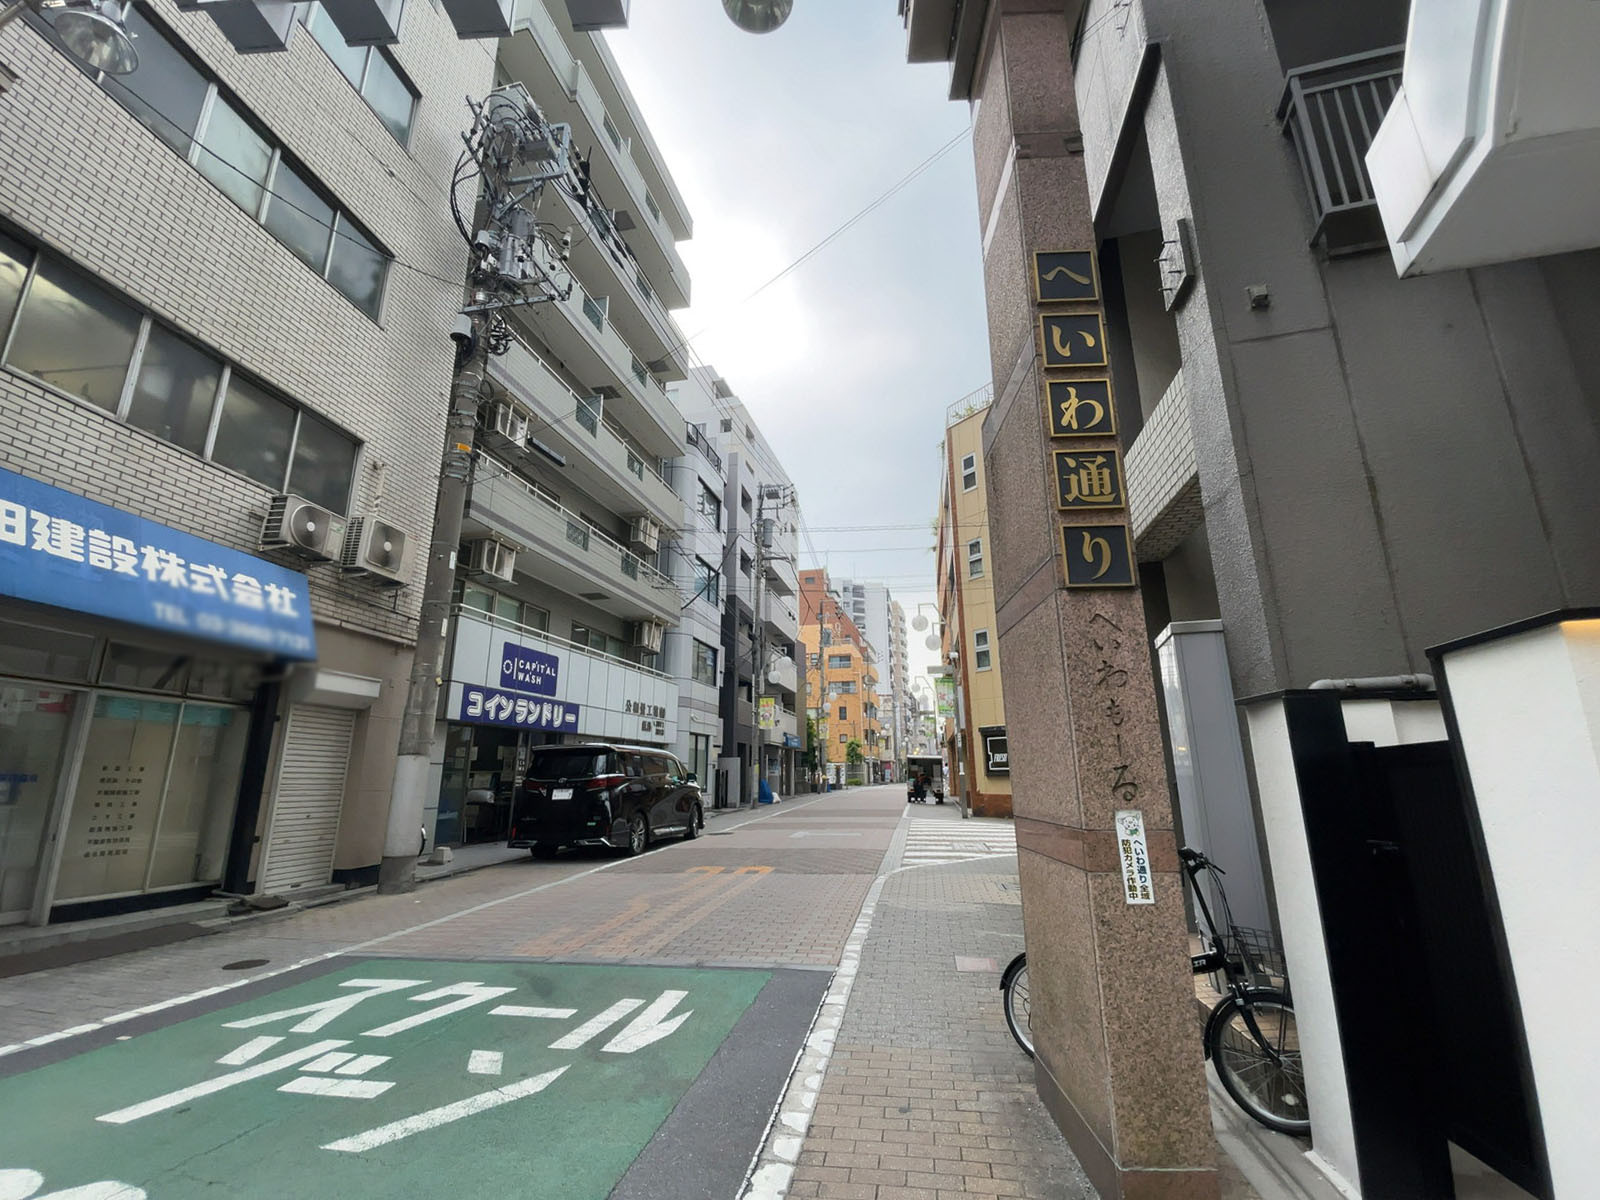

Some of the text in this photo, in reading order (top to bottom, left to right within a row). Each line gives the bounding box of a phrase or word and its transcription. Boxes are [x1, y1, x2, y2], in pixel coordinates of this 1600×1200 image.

[1041, 265, 1117, 580] へいわ通り
[517, 671, 542, 685] WASH
[519, 659, 557, 677] CAPITAL
[467, 691, 577, 728] コインランドリー
[221, 977, 695, 1054] スクール
[96, 1037, 573, 1154] ゾーン
